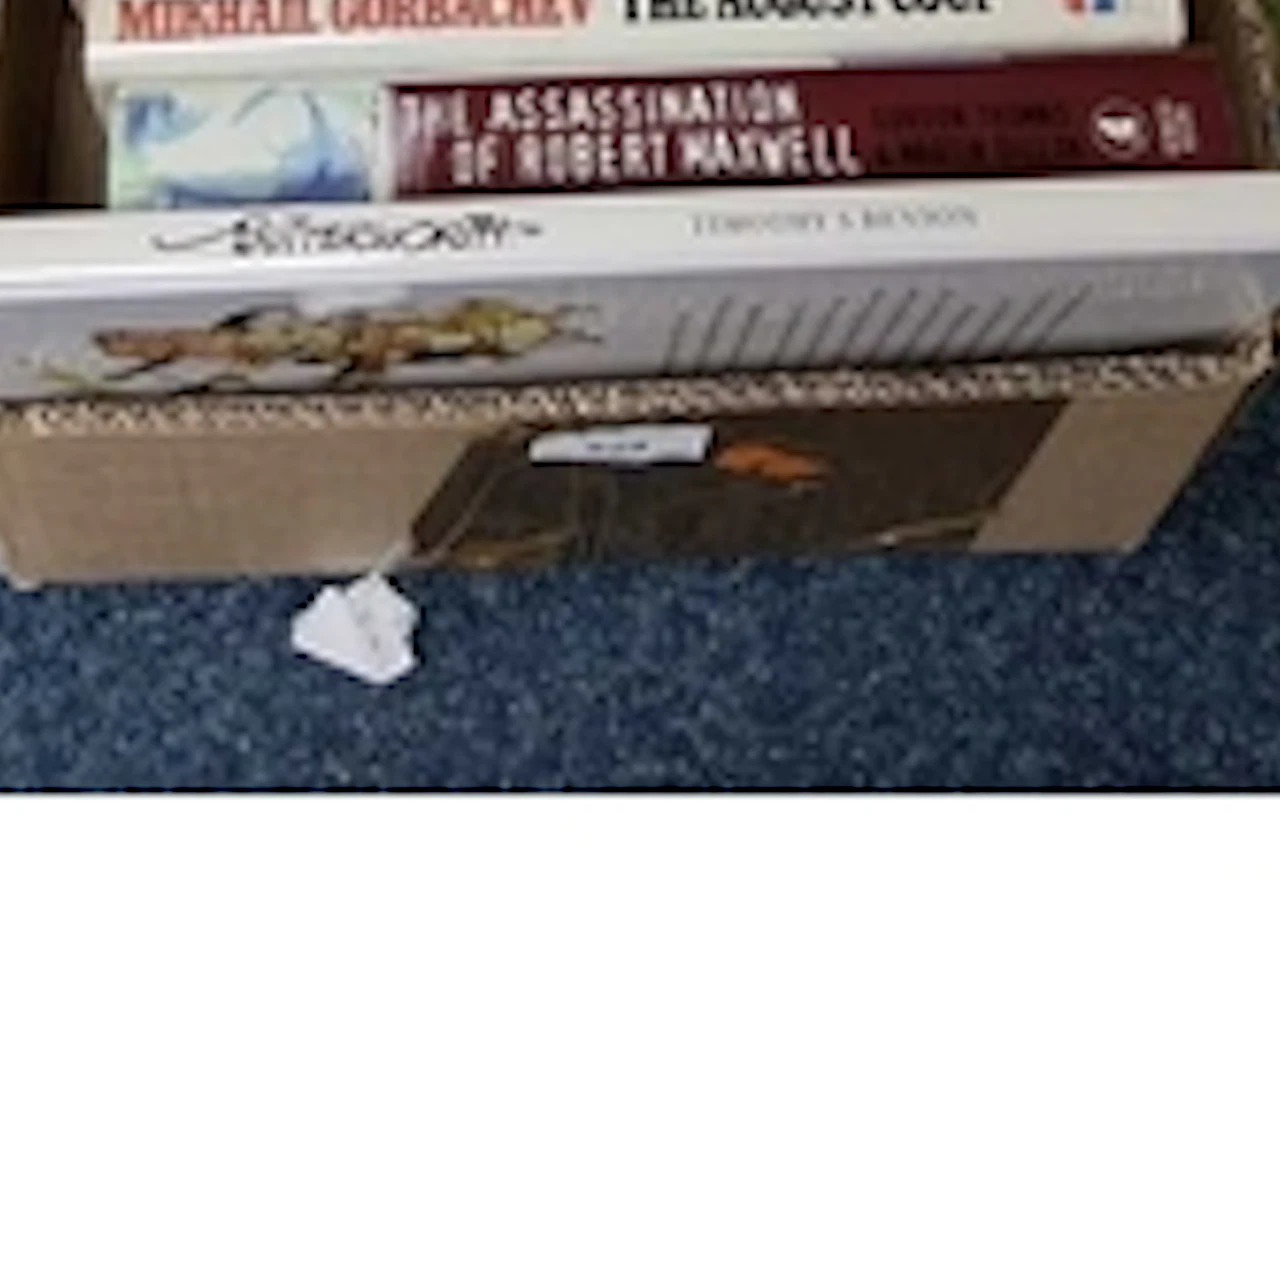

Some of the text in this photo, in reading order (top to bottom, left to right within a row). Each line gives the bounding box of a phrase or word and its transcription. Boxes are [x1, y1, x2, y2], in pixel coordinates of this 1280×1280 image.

[488, 81, 799, 130] ASSASSINATION
[453, 125, 864, 185] OF ROBERT MAXWELL
